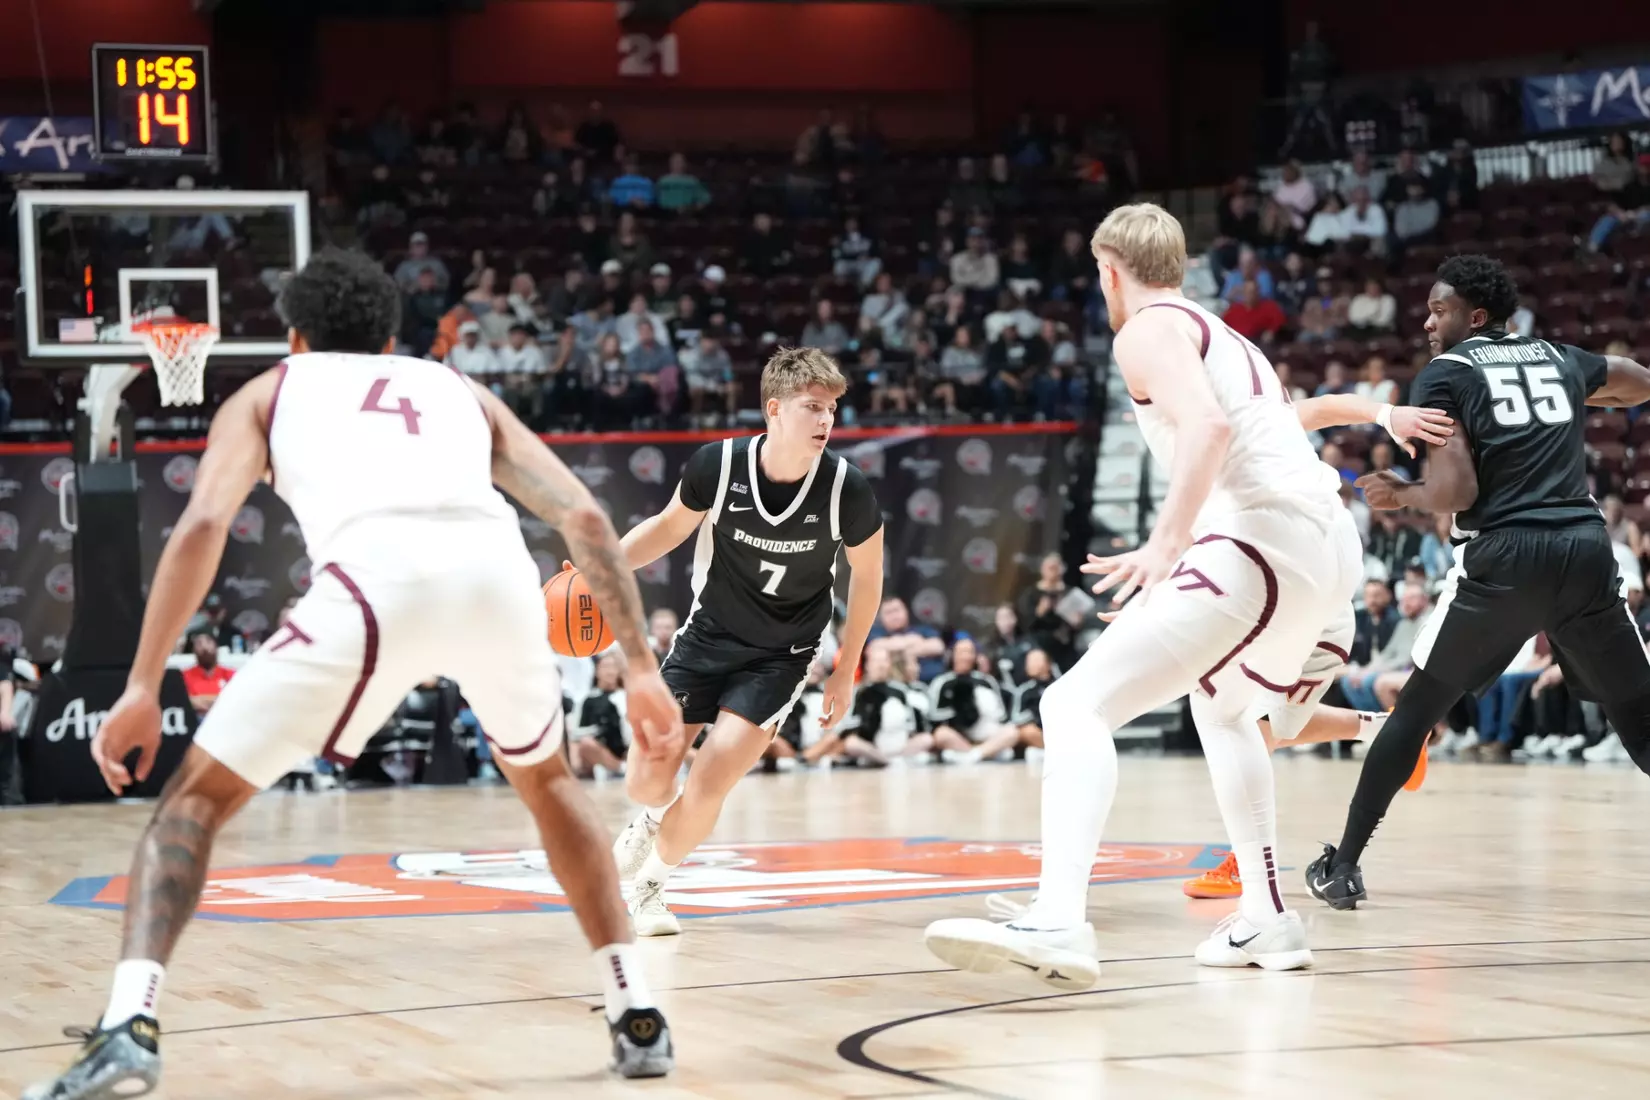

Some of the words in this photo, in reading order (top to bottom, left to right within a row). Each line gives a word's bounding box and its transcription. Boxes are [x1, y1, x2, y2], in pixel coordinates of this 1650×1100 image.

[116, 56, 197, 90] 11:55
[617, 32, 679, 76] 21
[138, 91, 191, 146] 14
[359, 377, 422, 436] 4
[1481, 363, 1574, 427] 55
[733, 527, 818, 554] PROVIDENCE
[759, 559, 788, 596] 7
[578, 594, 594, 641] ELITE
